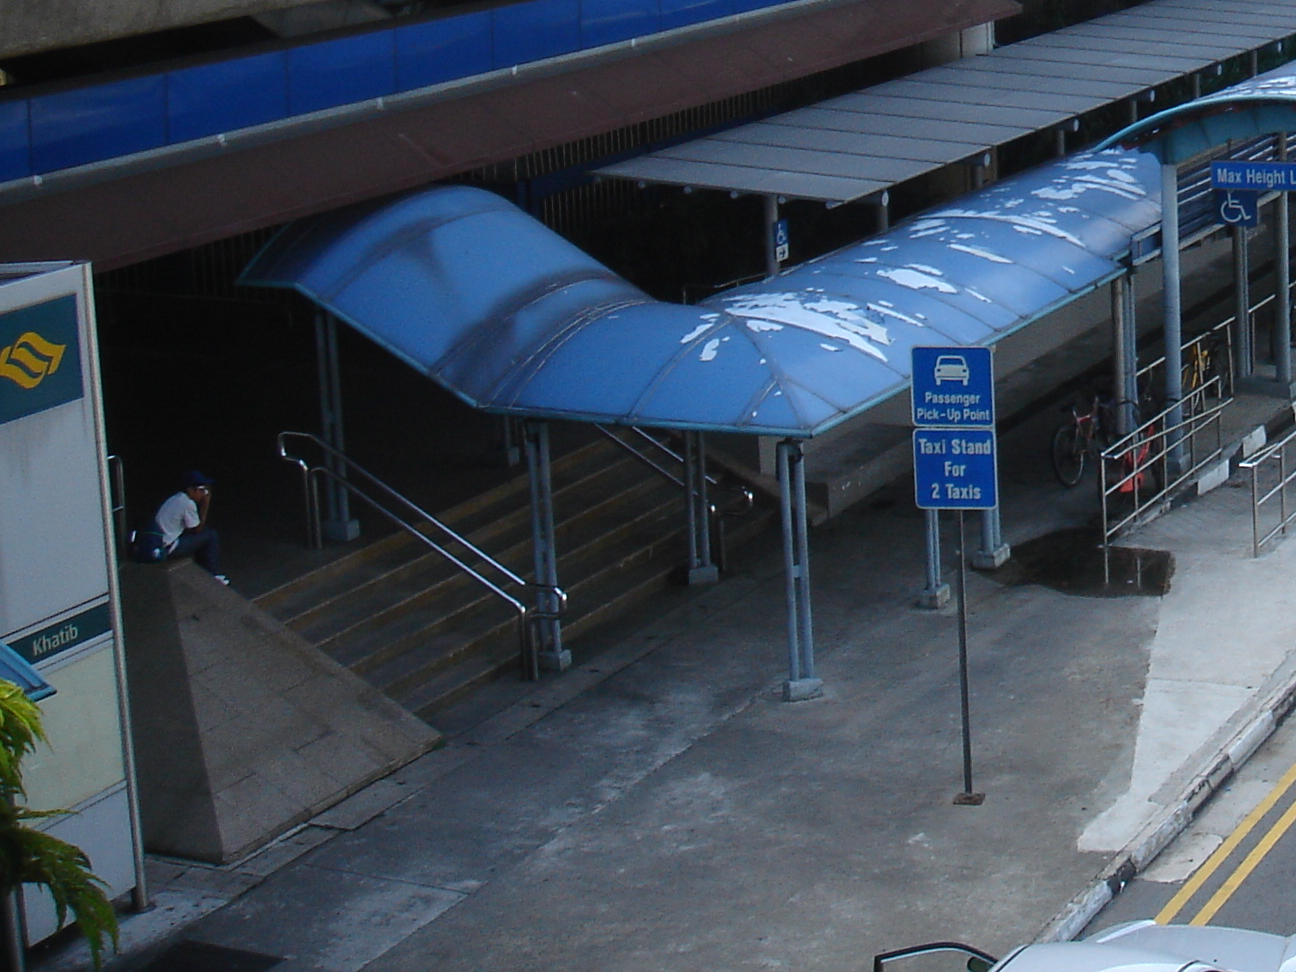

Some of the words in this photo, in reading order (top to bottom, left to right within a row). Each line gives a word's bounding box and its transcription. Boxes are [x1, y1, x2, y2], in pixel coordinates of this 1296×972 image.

[1217, 168, 1242, 184] Max
[1246, 168, 1286, 188] Height
[925, 391, 981, 407] Passenger
[916, 407, 961, 423] Pick-Up
[963, 408, 990, 421] Point
[918, 438, 946, 455] Taxi
[951, 438, 991, 455] Stand
[944, 461, 966, 477] For
[931, 483, 940, 499] 2
[945, 483, 982, 500] Taxis
[33, 624, 79, 656] Khatib
